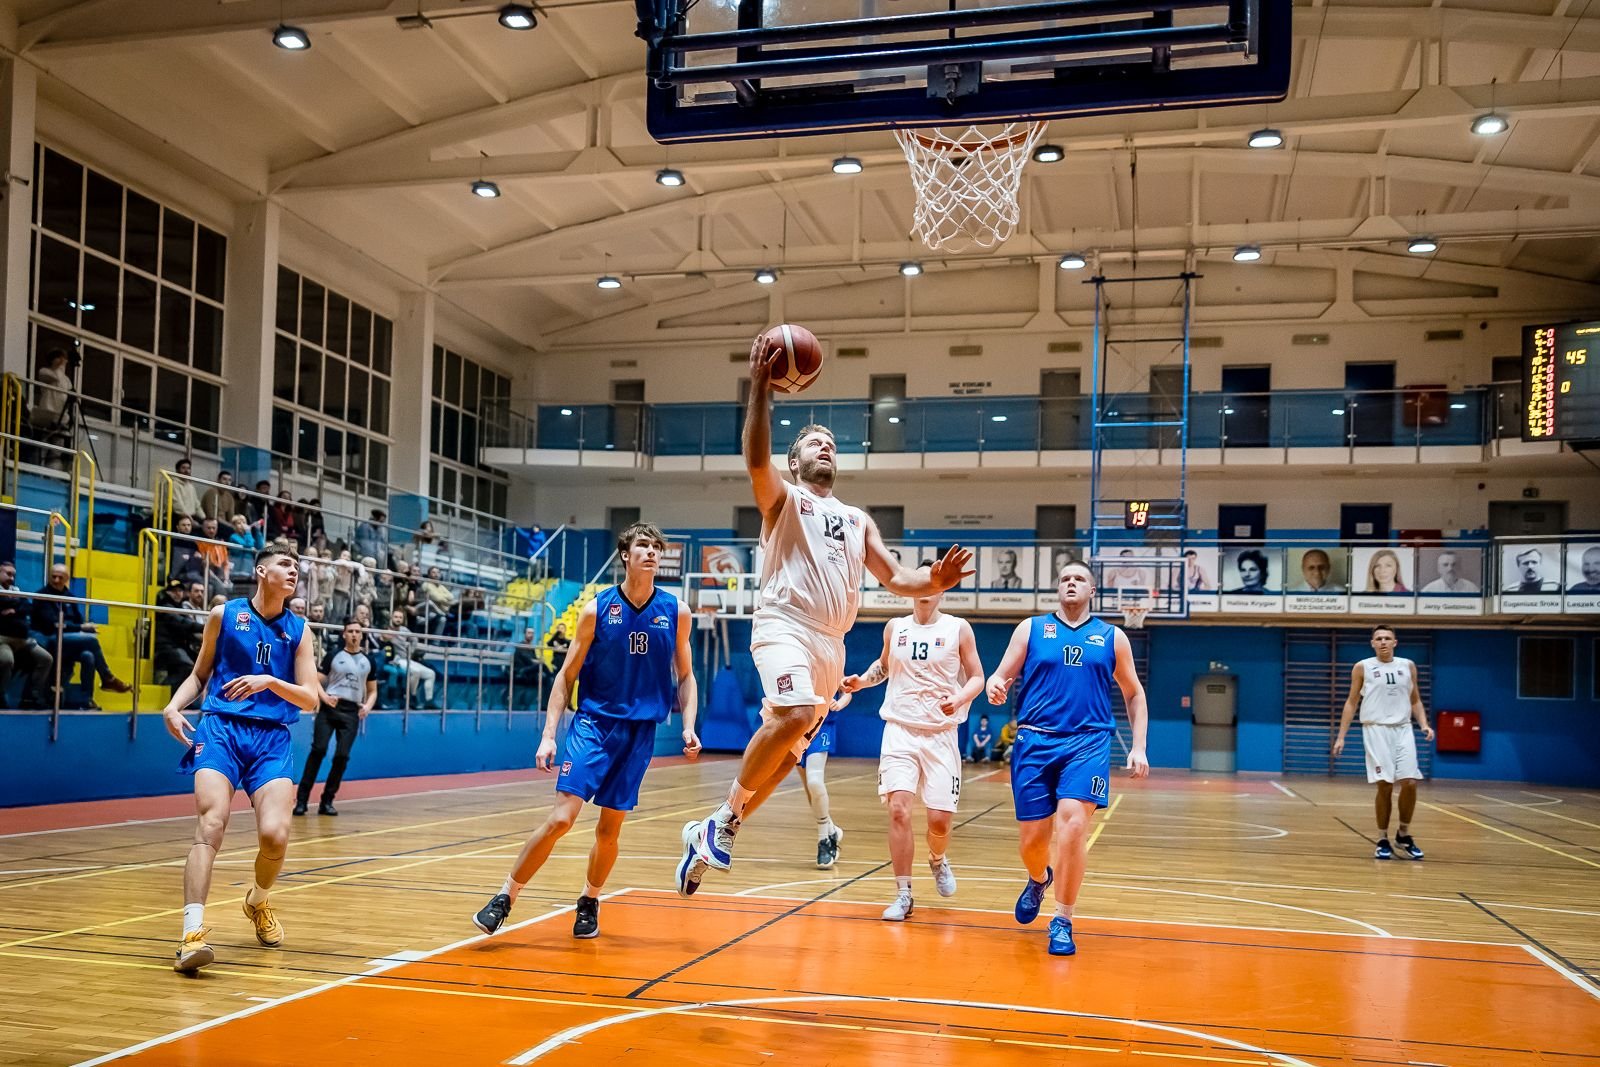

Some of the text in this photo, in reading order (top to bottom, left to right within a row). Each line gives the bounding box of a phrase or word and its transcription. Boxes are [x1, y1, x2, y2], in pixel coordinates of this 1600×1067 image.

[1566, 349, 1586, 365] 45
[1561, 381, 1571, 393] 0
[822, 514, 845, 541] 12
[1132, 511, 1147, 525] 19
[256, 640, 272, 665] 11
[628, 631, 648, 655] 13
[912, 641, 928, 660] 13
[1063, 644, 1083, 666] 12
[1385, 672, 1396, 684] 11
[951, 775, 960, 796] 13
[1091, 775, 1106, 798] 12
